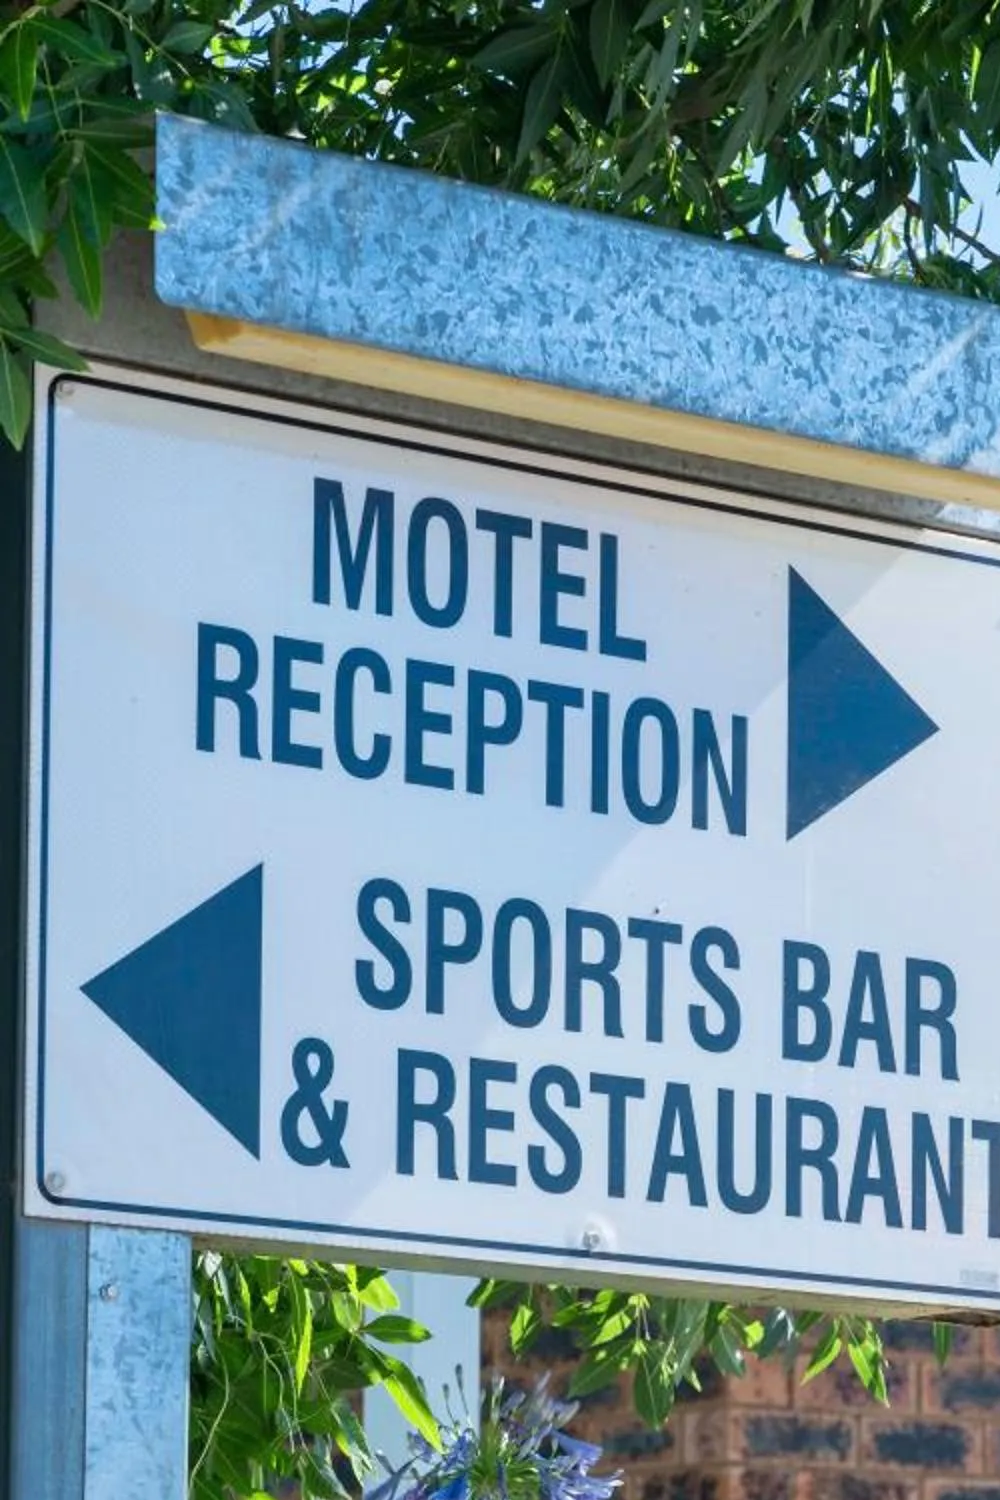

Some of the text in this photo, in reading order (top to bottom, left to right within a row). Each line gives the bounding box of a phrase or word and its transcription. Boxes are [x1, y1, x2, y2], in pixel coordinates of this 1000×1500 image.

[311, 475, 648, 664] MOTEL
[195, 620, 749, 838] RECEPTION
[354, 877, 960, 1082] SPORTS BAR
[279, 1036, 351, 1169] &
